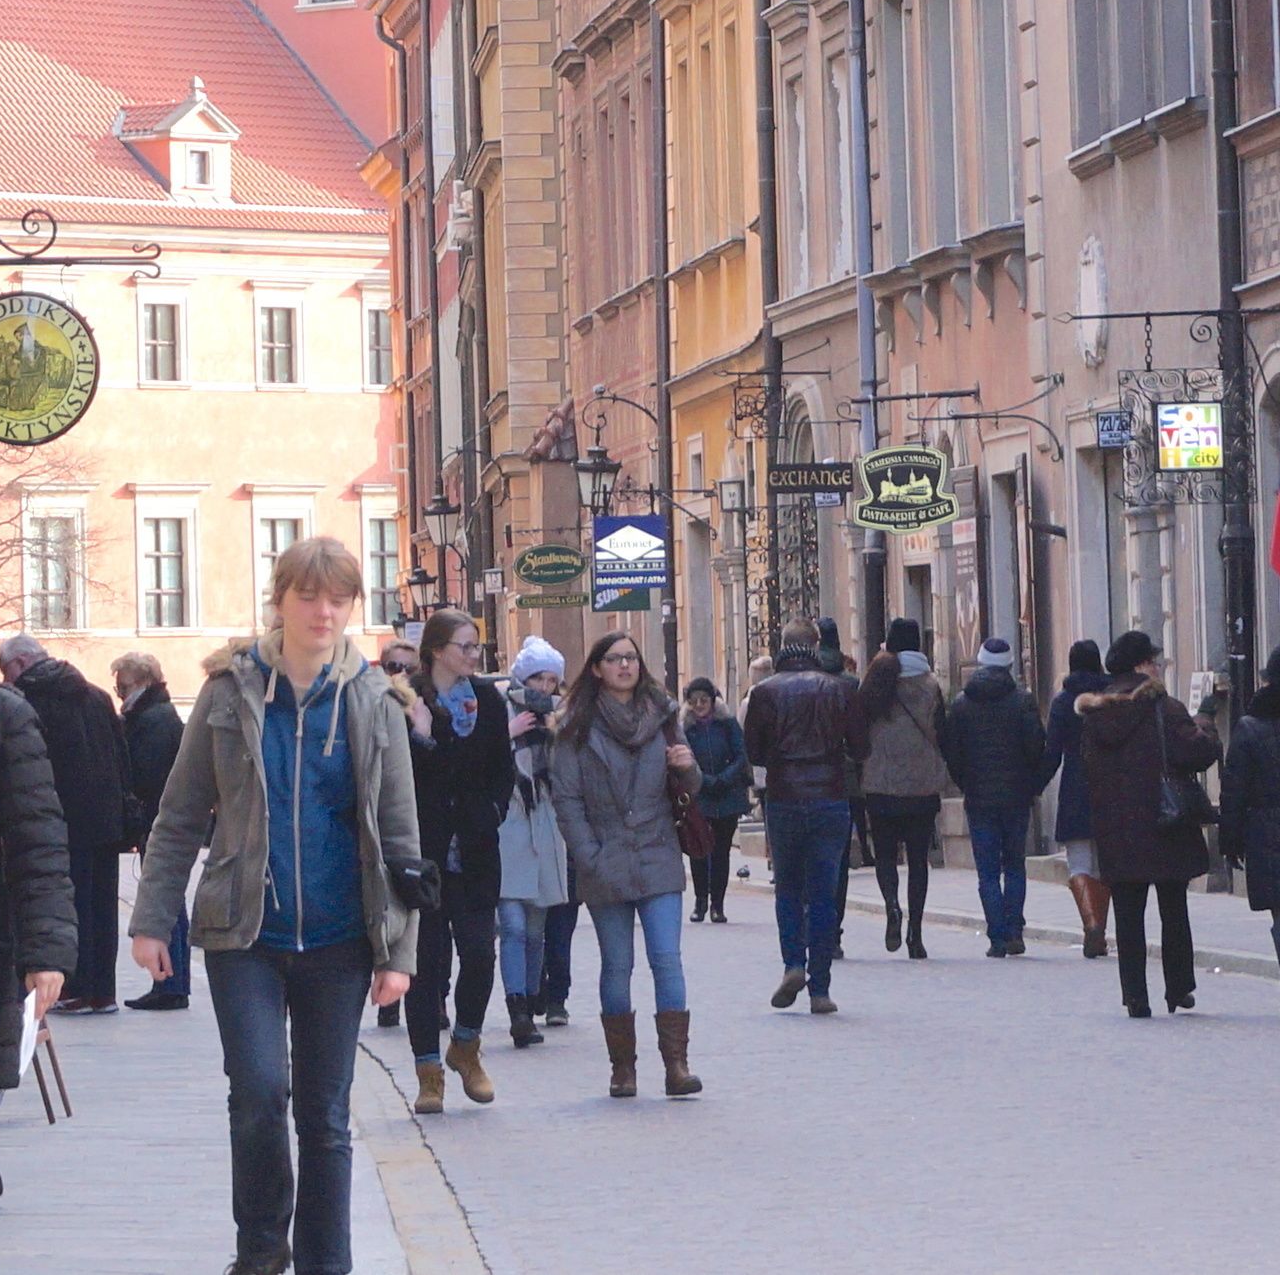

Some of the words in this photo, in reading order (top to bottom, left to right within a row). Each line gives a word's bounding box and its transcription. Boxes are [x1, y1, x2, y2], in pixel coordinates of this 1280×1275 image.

[1160, 405, 1217, 426] sou
[1161, 428, 1217, 447] ven
[1194, 451, 1219, 465] city
[769, 469, 852, 486] EXCHANGE
[862, 508, 916, 521] PATISSERIE
[608, 538, 652, 549] Euronet
